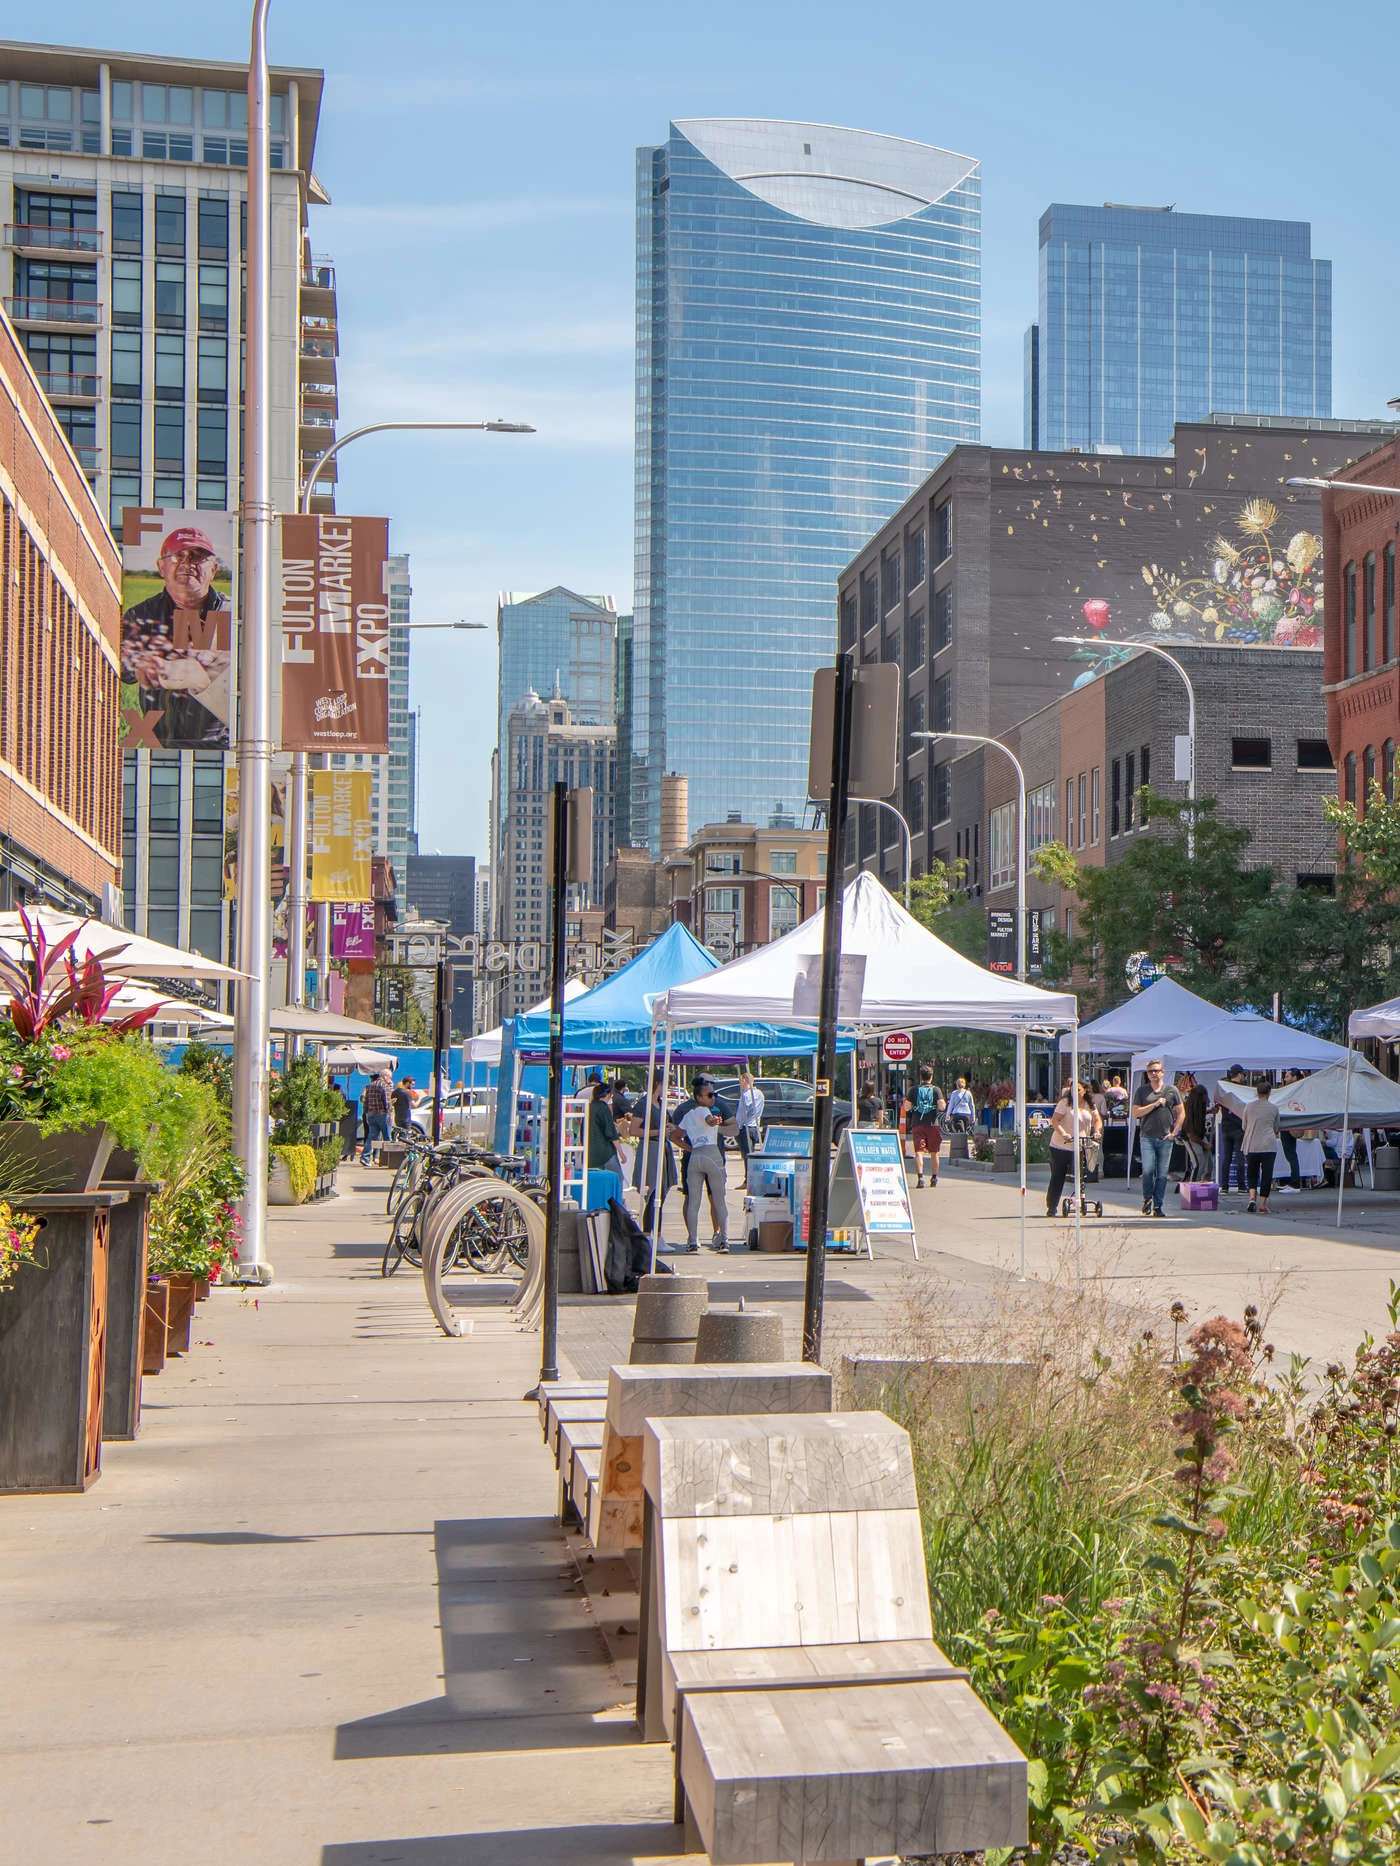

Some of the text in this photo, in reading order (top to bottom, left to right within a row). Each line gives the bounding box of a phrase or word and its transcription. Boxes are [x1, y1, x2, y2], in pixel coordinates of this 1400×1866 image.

[319, 515, 352, 633] MARKET
[281, 559, 315, 664] FULTON
[356, 603, 389, 679] EXPO
[313, 730, 358, 739] westloop.org
[312, 795, 331, 854] FULTON
[333, 771, 352, 837] MARKET
[353, 819, 372, 862] EXPO
[990, 962, 1013, 971] Knoll
[591, 1028, 630, 1045] PURE.
